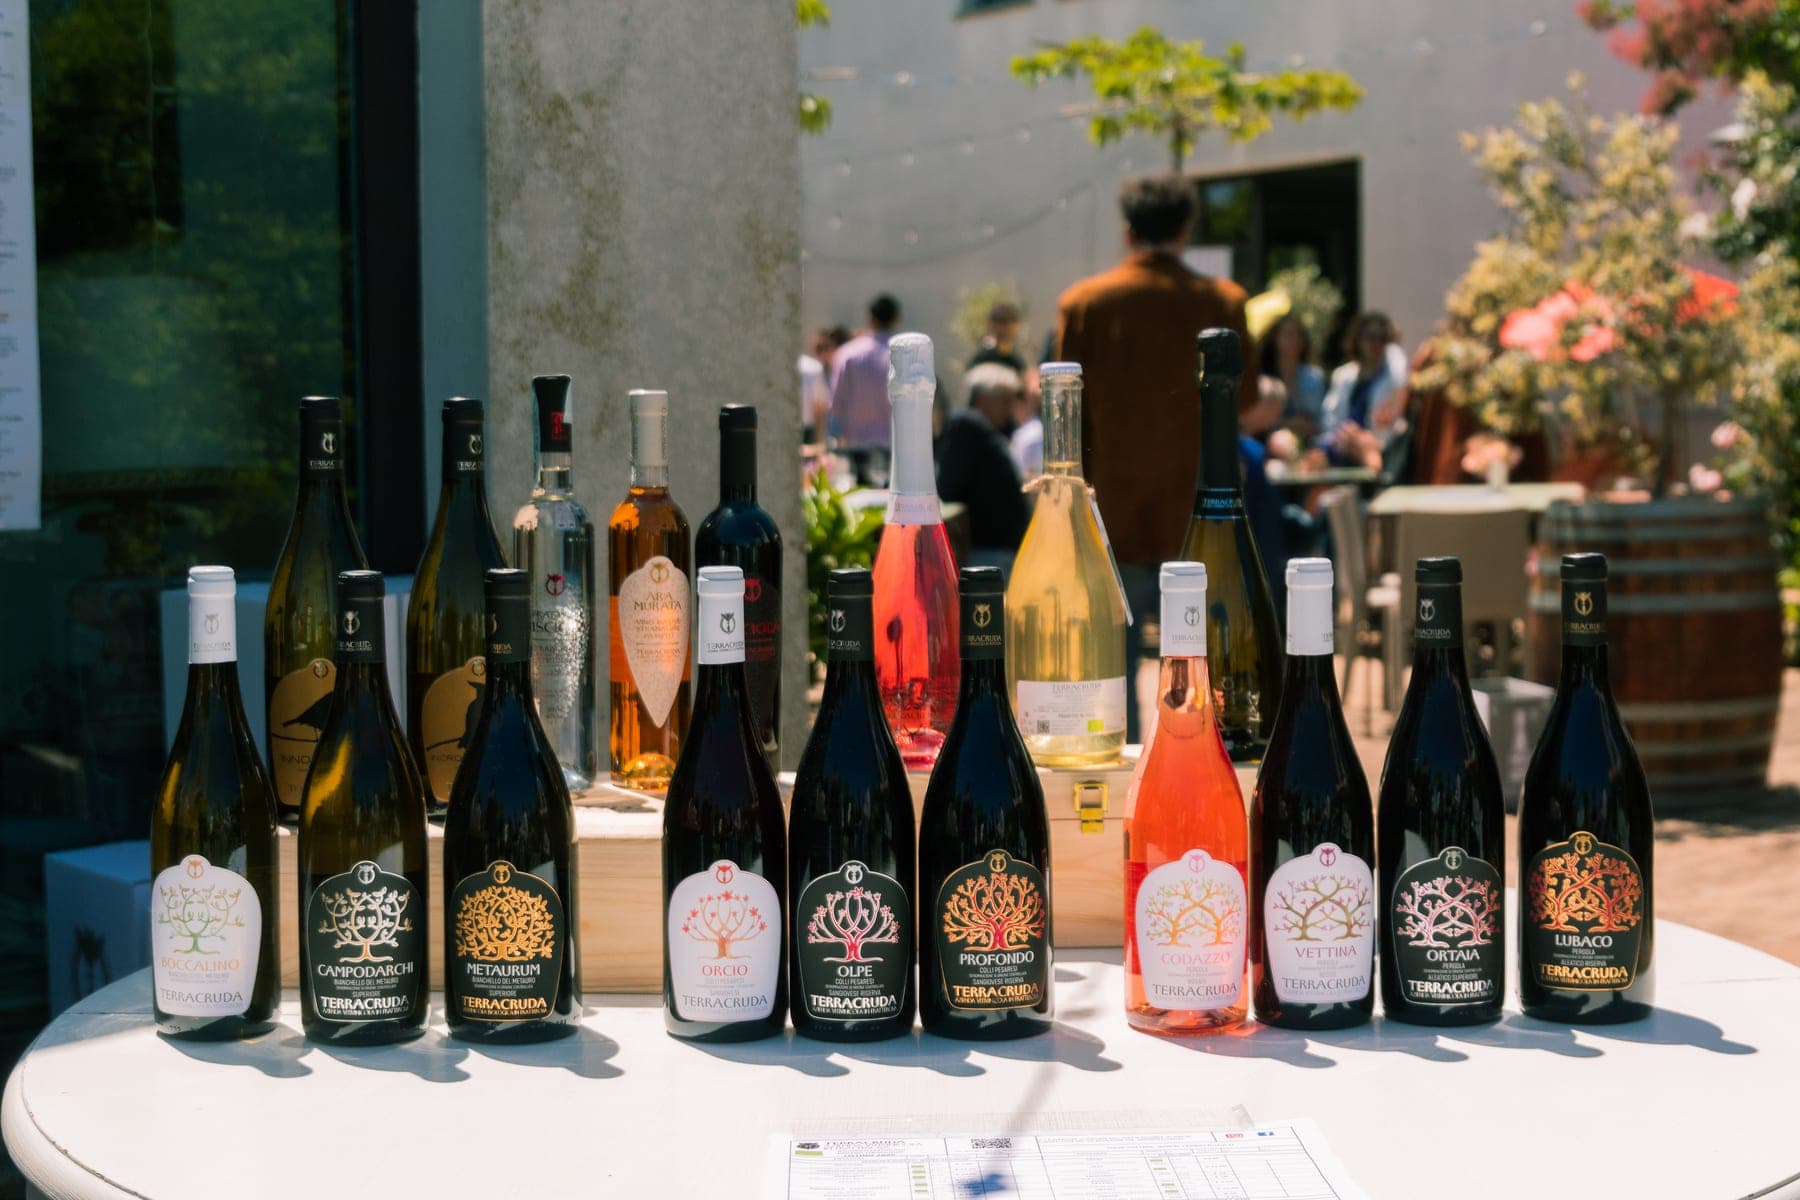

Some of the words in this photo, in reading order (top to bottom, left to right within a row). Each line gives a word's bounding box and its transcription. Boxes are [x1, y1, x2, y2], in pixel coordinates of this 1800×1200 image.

[1555, 934, 1613, 947] LUBACO
[960, 950, 1034, 966] PROFONDO
[1161, 952, 1231, 965] CODAZZO
[1295, 945, 1357, 958] VETTINA
[1426, 949, 1480, 961] ORTAIA
[160, 957, 240, 972] BOCCALINO
[318, 962, 413, 978] CAMPODARCHI
[467, 963, 540, 976] METAURUM
[701, 964, 748, 976] ORCIO
[837, 965, 872, 977] OLPE
[1539, 964, 1628, 978] TERRACRUDA
[953, 983, 1038, 997] TERRACRUDA
[1153, 982, 1237, 996] TERRACRUDA
[1281, 976, 1366, 990] TERRACRUDA
[1408, 979, 1493, 993] TERRACRUDA
[160, 988, 243, 1004] TERRACRUDA
[320, 995, 409, 1009] TERRACRUDA
[462, 996, 547, 1010] TERRACRUDA
[682, 994, 768, 1009] TERRACRUDA
[810, 994, 896, 1009] TERRACRUDA
